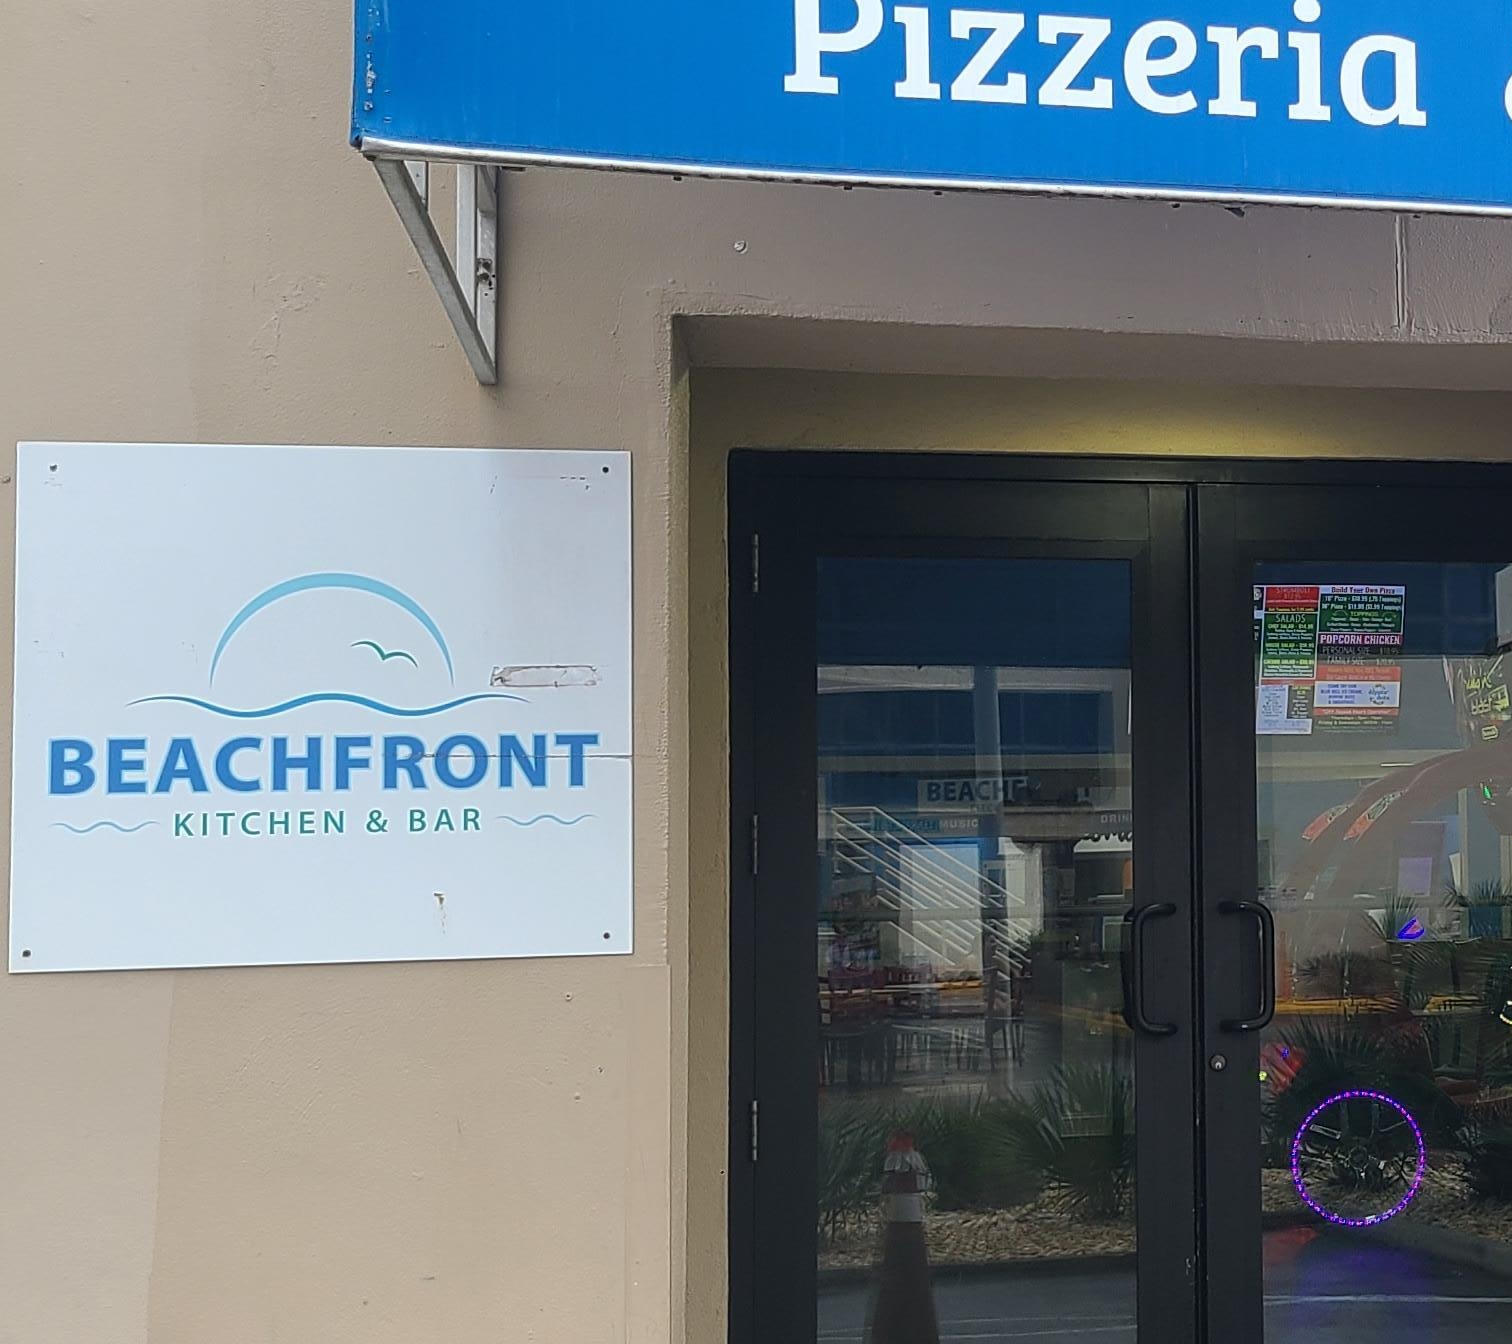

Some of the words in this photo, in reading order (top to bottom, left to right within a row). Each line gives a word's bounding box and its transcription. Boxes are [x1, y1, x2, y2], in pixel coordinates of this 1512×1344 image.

[1275, 613, 1306, 623] SALADS
[1320, 634, 1362, 645] POPCORN
[1363, 635, 1401, 645] CHICKEN
[47, 733, 601, 798] BEACHFRONT
[173, 810, 346, 837] KITCHEN
[365, 812, 389, 834] &
[408, 807, 483, 833] BAR
[939, 818, 979, 830] MUSIC
[1100, 814, 1132, 825] DRIN
